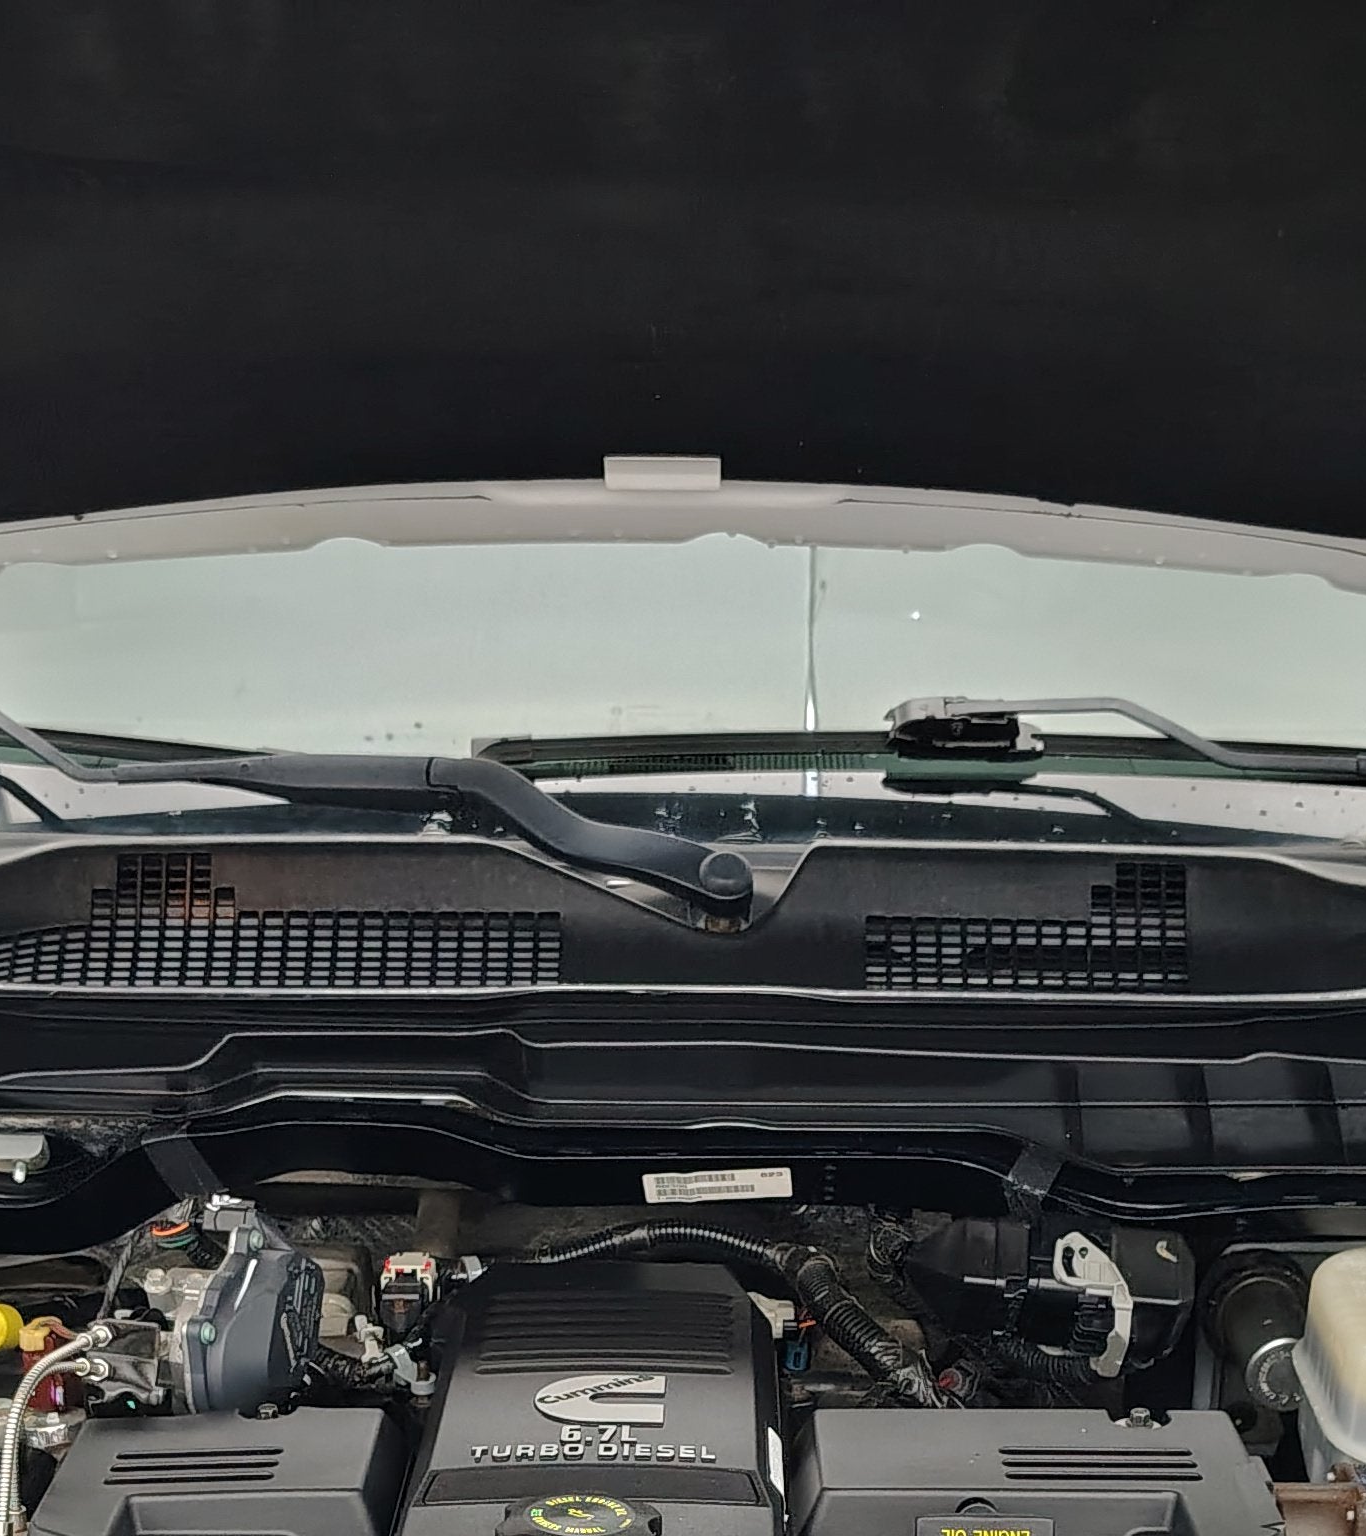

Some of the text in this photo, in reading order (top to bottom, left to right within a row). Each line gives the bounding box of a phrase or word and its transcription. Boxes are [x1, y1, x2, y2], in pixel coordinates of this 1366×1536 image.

[536, 1373, 656, 1406] Cummins
[559, 1424, 638, 1444] 6.7L
[471, 1443, 718, 1463] TURBO DIESEL
